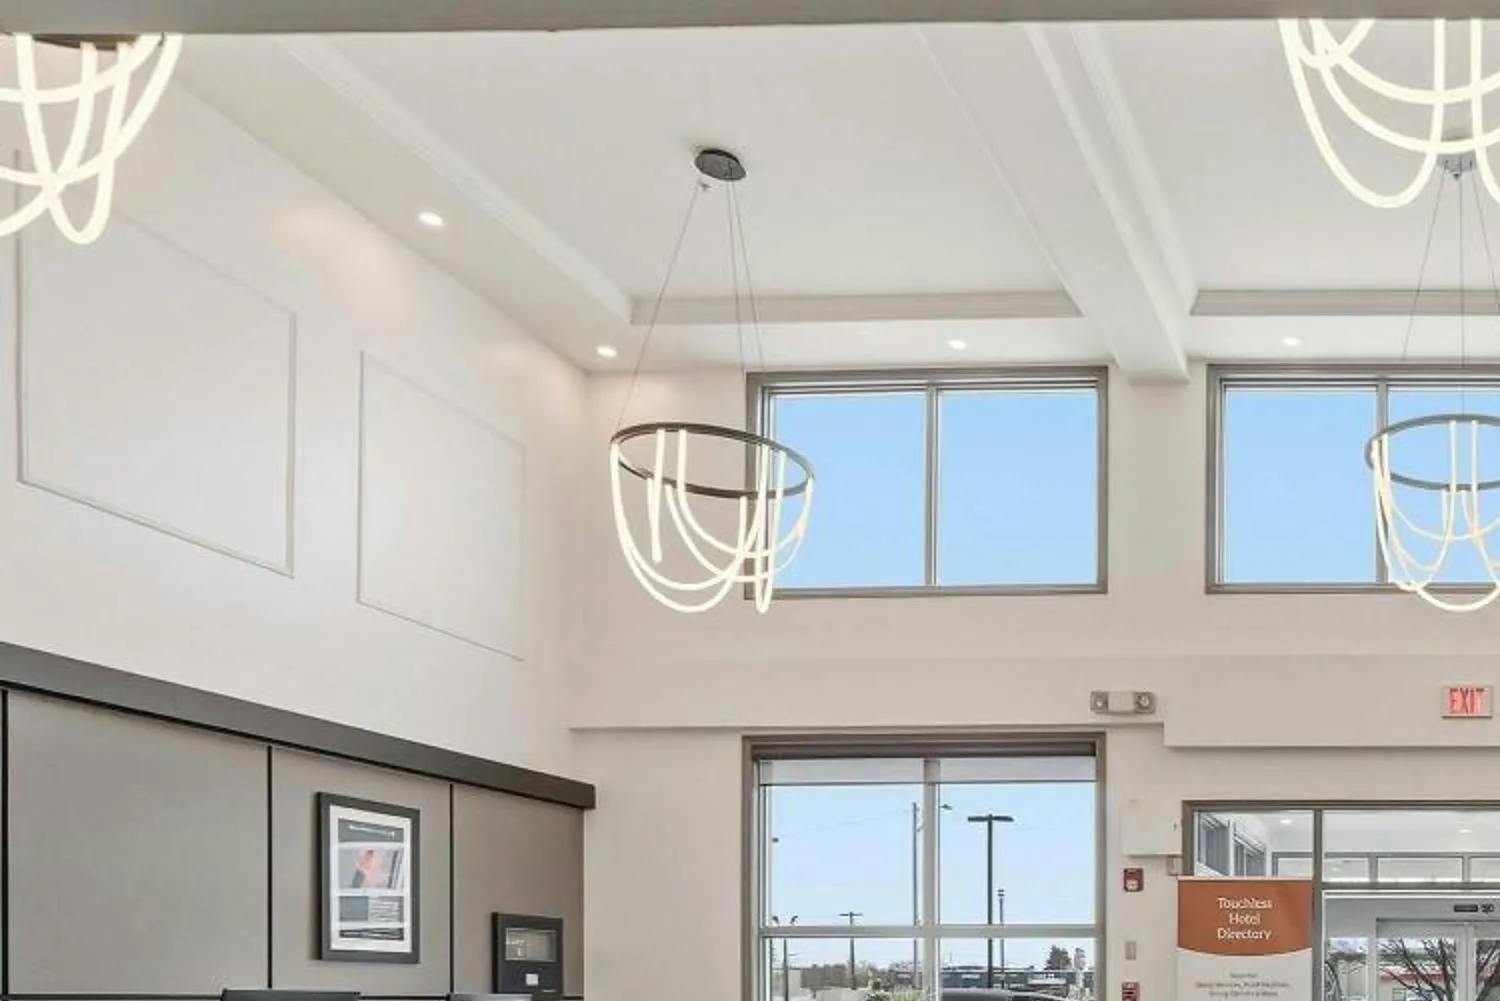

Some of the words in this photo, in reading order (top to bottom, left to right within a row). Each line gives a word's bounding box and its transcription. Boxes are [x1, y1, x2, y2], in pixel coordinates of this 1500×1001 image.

[1449, 687, 1486, 714] EXIT
[1217, 897, 1272, 909] Touchless
[1229, 912, 1261, 925] Hotel
[1217, 927, 1273, 941] Directory
